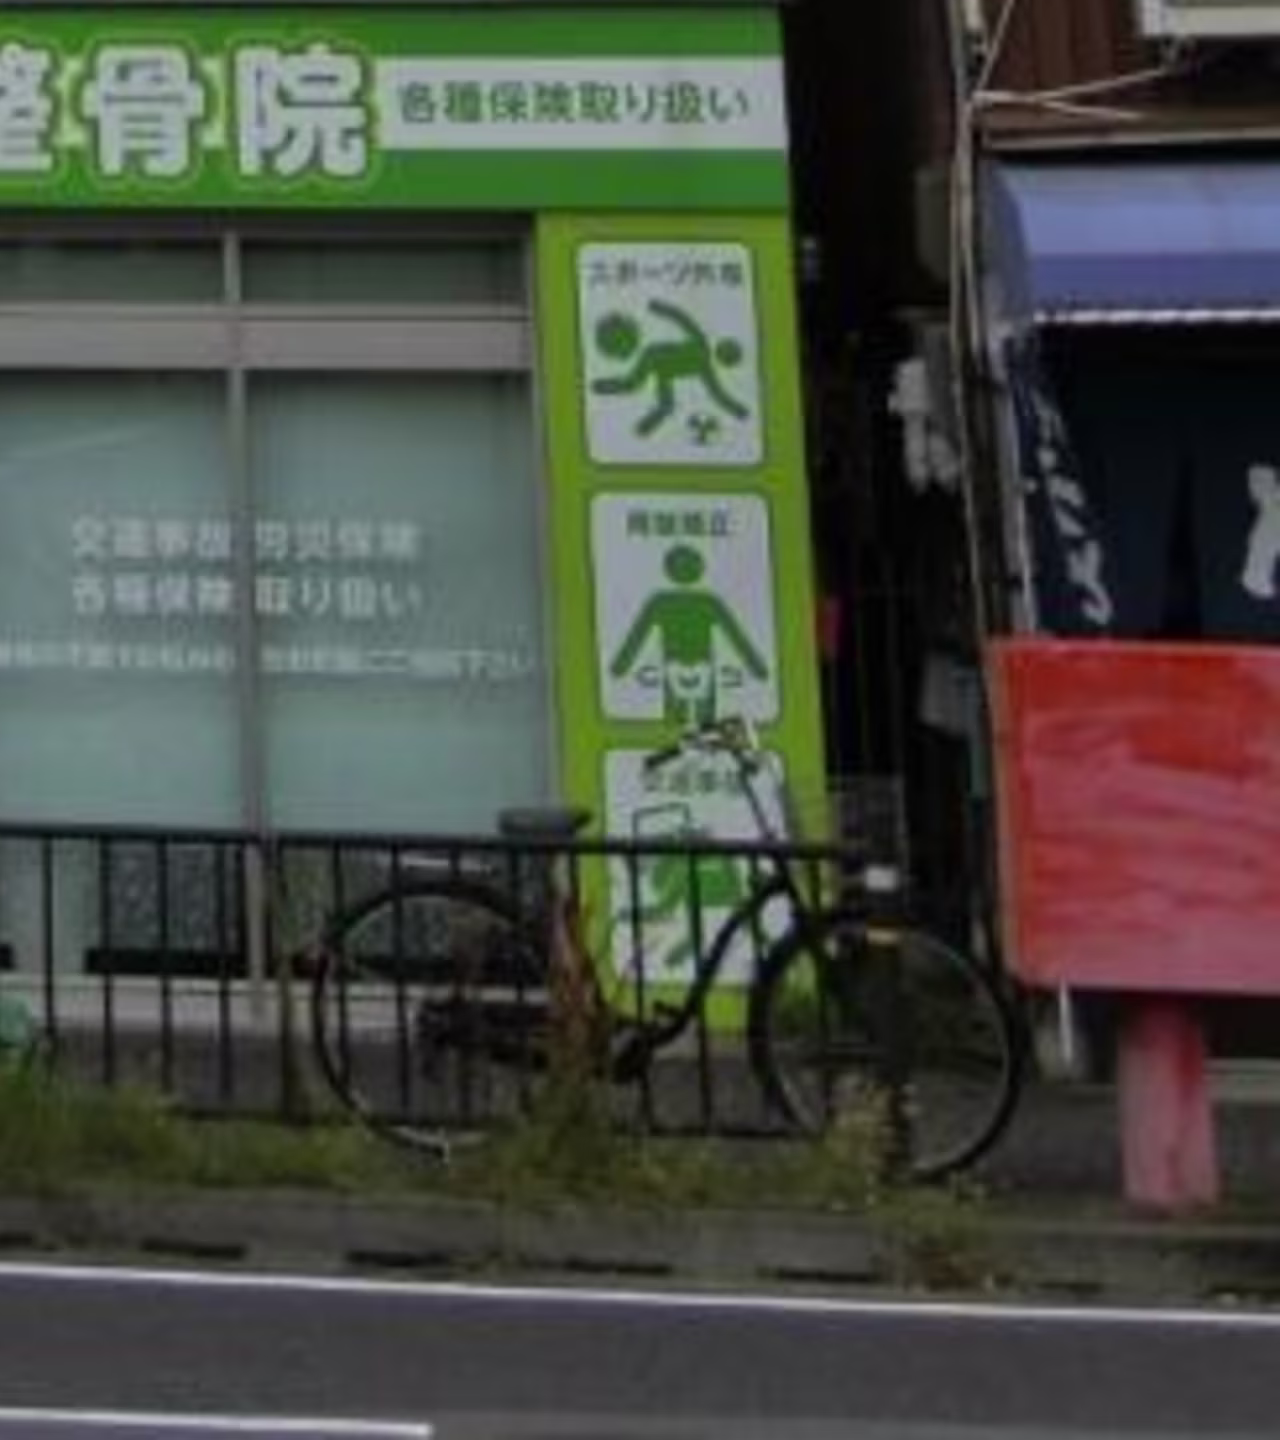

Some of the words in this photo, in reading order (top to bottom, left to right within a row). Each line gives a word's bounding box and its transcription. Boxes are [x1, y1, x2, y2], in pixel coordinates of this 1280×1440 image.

[401, 80, 750, 123] 各種保険取り扱い
